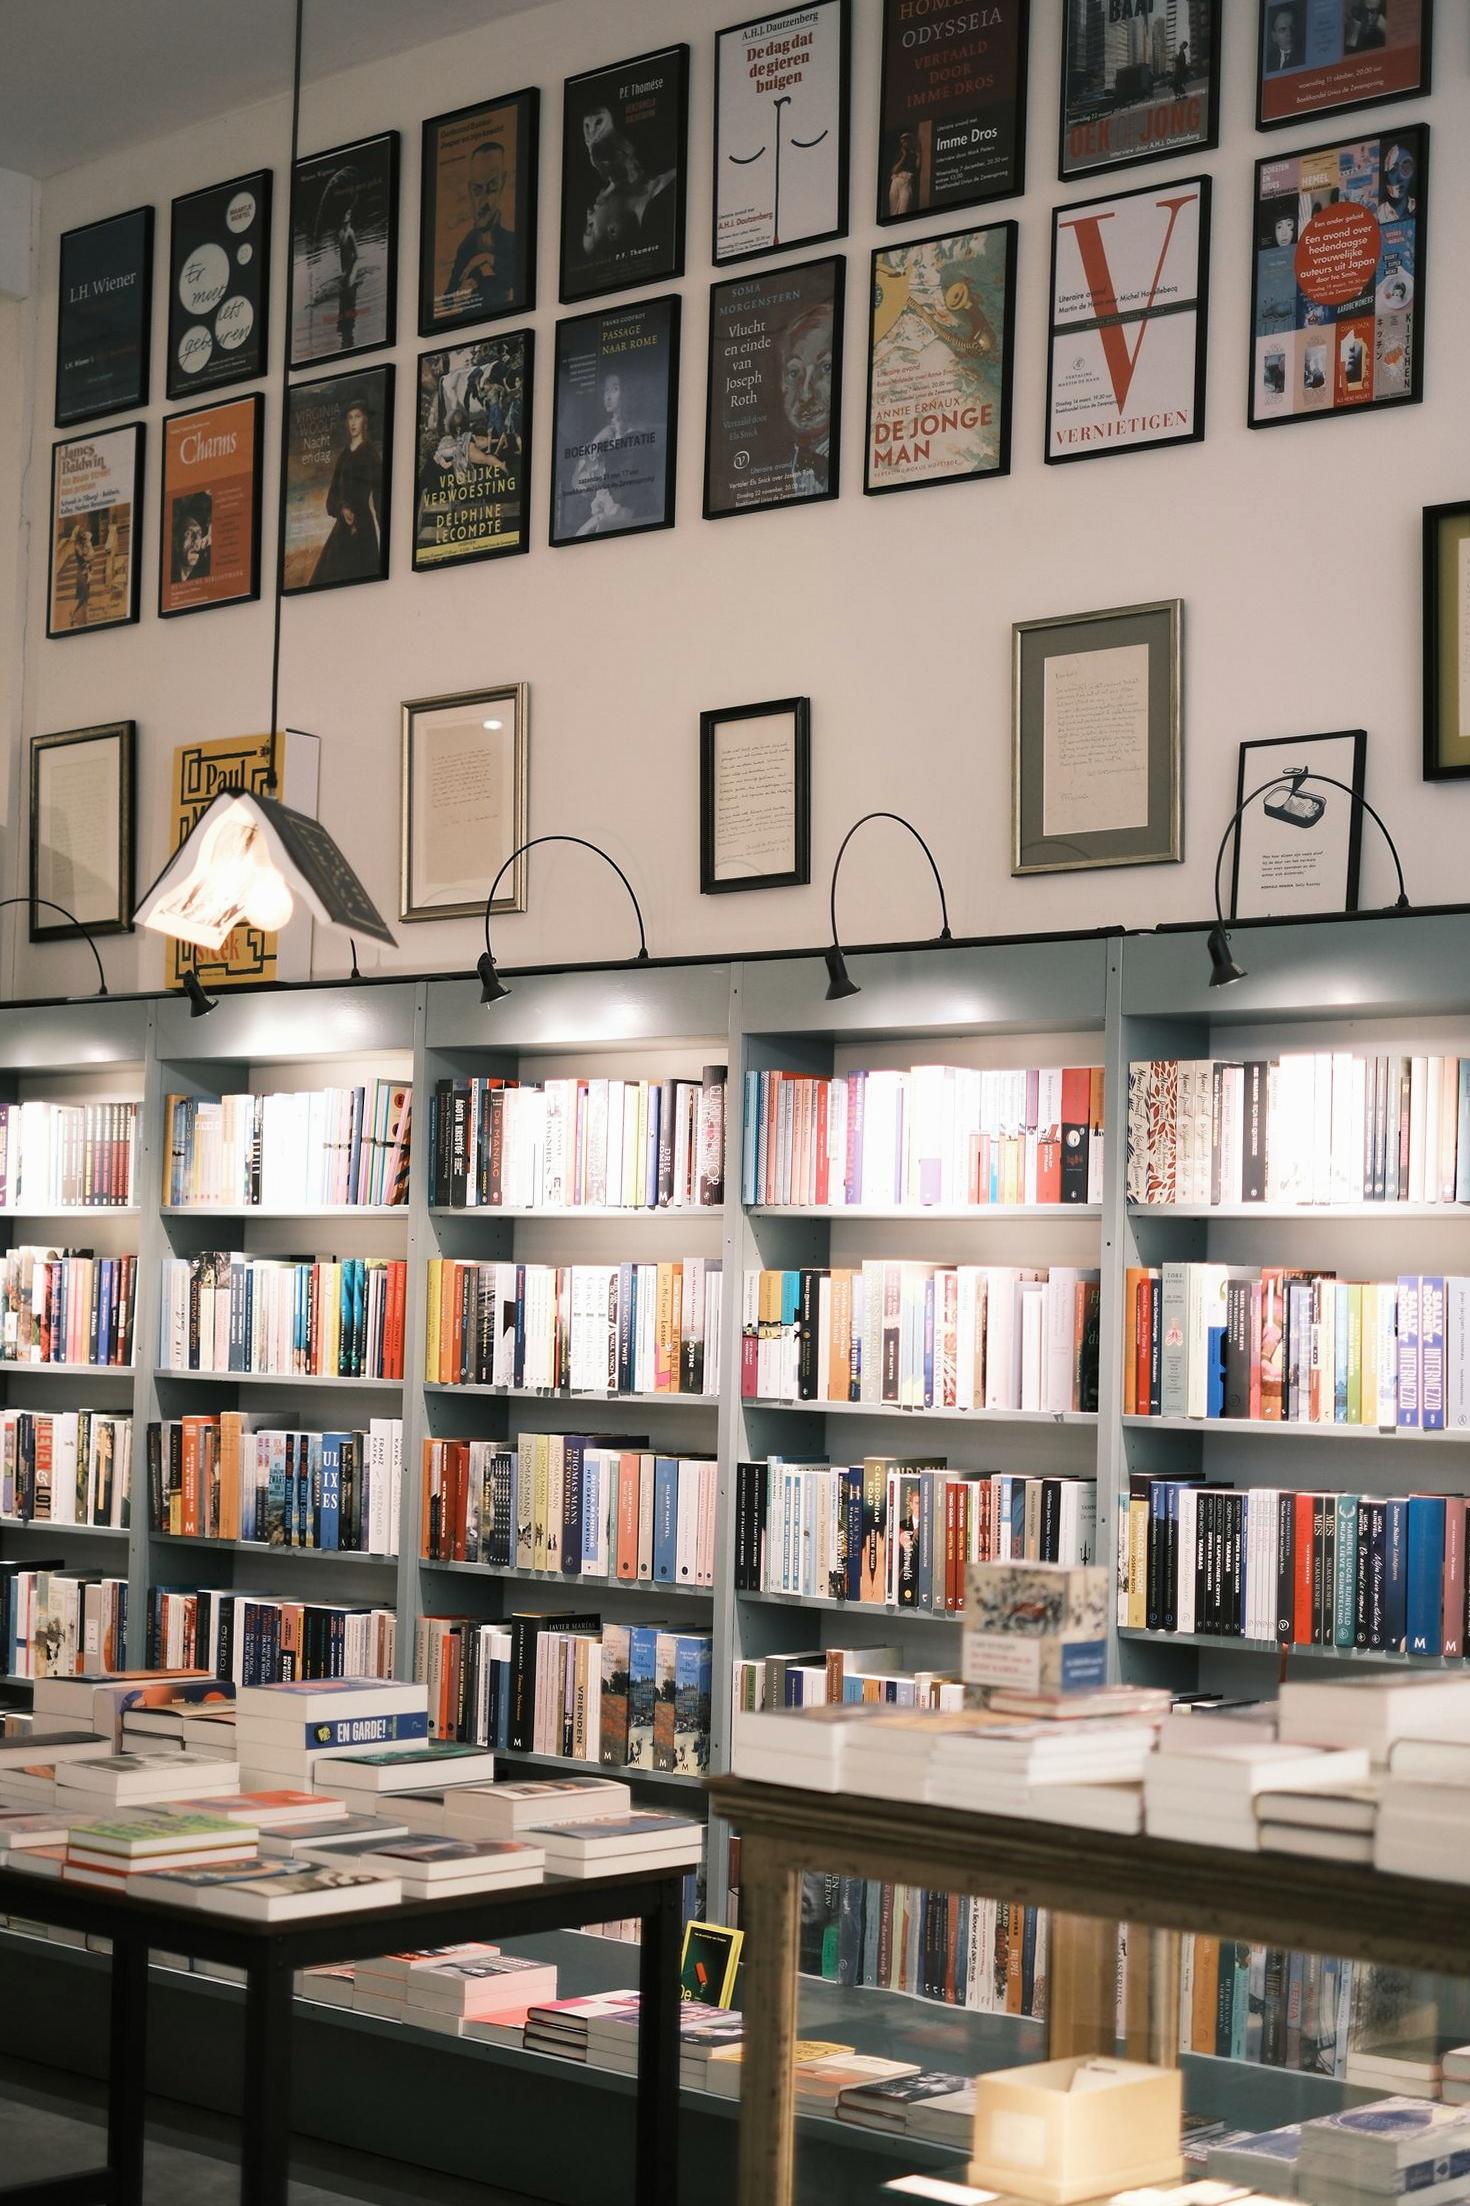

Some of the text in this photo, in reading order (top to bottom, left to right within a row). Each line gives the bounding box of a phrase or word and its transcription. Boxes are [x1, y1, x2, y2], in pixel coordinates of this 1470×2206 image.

[742, 12, 818, 40] A.H.J. Dautzenberg
[902, 7, 1003, 48] ODYSSEIA
[747, 31, 813, 62] De dag dat
[914, 41, 988, 69] VERTAALD
[749, 51, 810, 78] de gieren
[929, 64, 971, 84] DOOR
[756, 71, 803, 94] buigen
[906, 74, 994, 108] IMME DROS
[936, 127, 998, 152] Imme Dros
[1305, 225, 1372, 245] Een avond over
[1308, 237, 1368, 255] hedendaagse
[1300, 258, 1375, 279] auteurs uit Japan
[1312, 249, 1364, 265] vrouwelijke
[94, 272, 137, 296] Wiener
[732, 283, 760, 298] SOMA
[720, 288, 801, 316] MORGENSTERN
[1058, 291, 1139, 314] Martin de Michel
[602, 324, 641, 341] PASSAGE
[728, 319, 766, 338] Vlucht
[601, 335, 658, 355] NAAR ROME
[724, 337, 772, 357] en einde
[1404, 312, 1412, 389] KITCHEN
[732, 359, 753, 372] van
[724, 372, 762, 393] Joseph
[730, 393, 758, 409] Roth
[876, 397, 960, 420] ANNIE ERNAUX
[874, 403, 992, 444] DE JONGE
[1056, 409, 1189, 445] VERNIETIGEN
[63, 445, 96, 461] James
[181, 430, 238, 466] Charms
[564, 431, 656, 460] BOEKPRESENTATIE
[873, 440, 930, 468] MAN
[439, 463, 501, 489] VROLIJKE
[423, 476, 516, 507] VERWOESTING
[436, 503, 501, 528] DELPHINE
[436, 519, 501, 543] LECOMPTE
[206, 759, 247, 796] Paul
[493, 1126, 501, 1178] MANIAC
[1400, 1286, 1410, 1344] ROONEY
[1408, 1291, 1418, 1333] SALLY
[1424, 1285, 1434, 1344] ROONEY
[1433, 1291, 1443, 1333] SALLY
[1400, 1348, 1417, 1411] INTERMEZZO
[1423, 1348, 1441, 1411] INTERMEZZO
[38, 1426, 52, 1470] LEVEN
[564, 1449, 573, 1526] DE TOVERBERG
[571, 1449, 580, 1527] THOMAS MANN
[866, 1481, 874, 1506] ROAD
[873, 1465, 881, 1524] CALEDONIAN
[185, 1521, 195, 1532] M
[1314, 1514, 1322, 1536] MES
[1325, 1514, 1334, 1537] MES
[549, 1620, 596, 1631] JAVIER MARÍAS
[219, 1625, 228, 1672] OSEBOL
[1414, 1637, 1426, 1650] M
[1445, 1641, 1457, 1652] M
[337, 1719, 386, 1743] EN GARDE!
[513, 1739, 522, 1747] M
[575, 1747, 583, 1758] M
[604, 1750, 612, 1760] M
[632, 1756, 640, 1765] M
[659, 1759, 667, 1768] M
[681, 1763, 689, 1771] M
